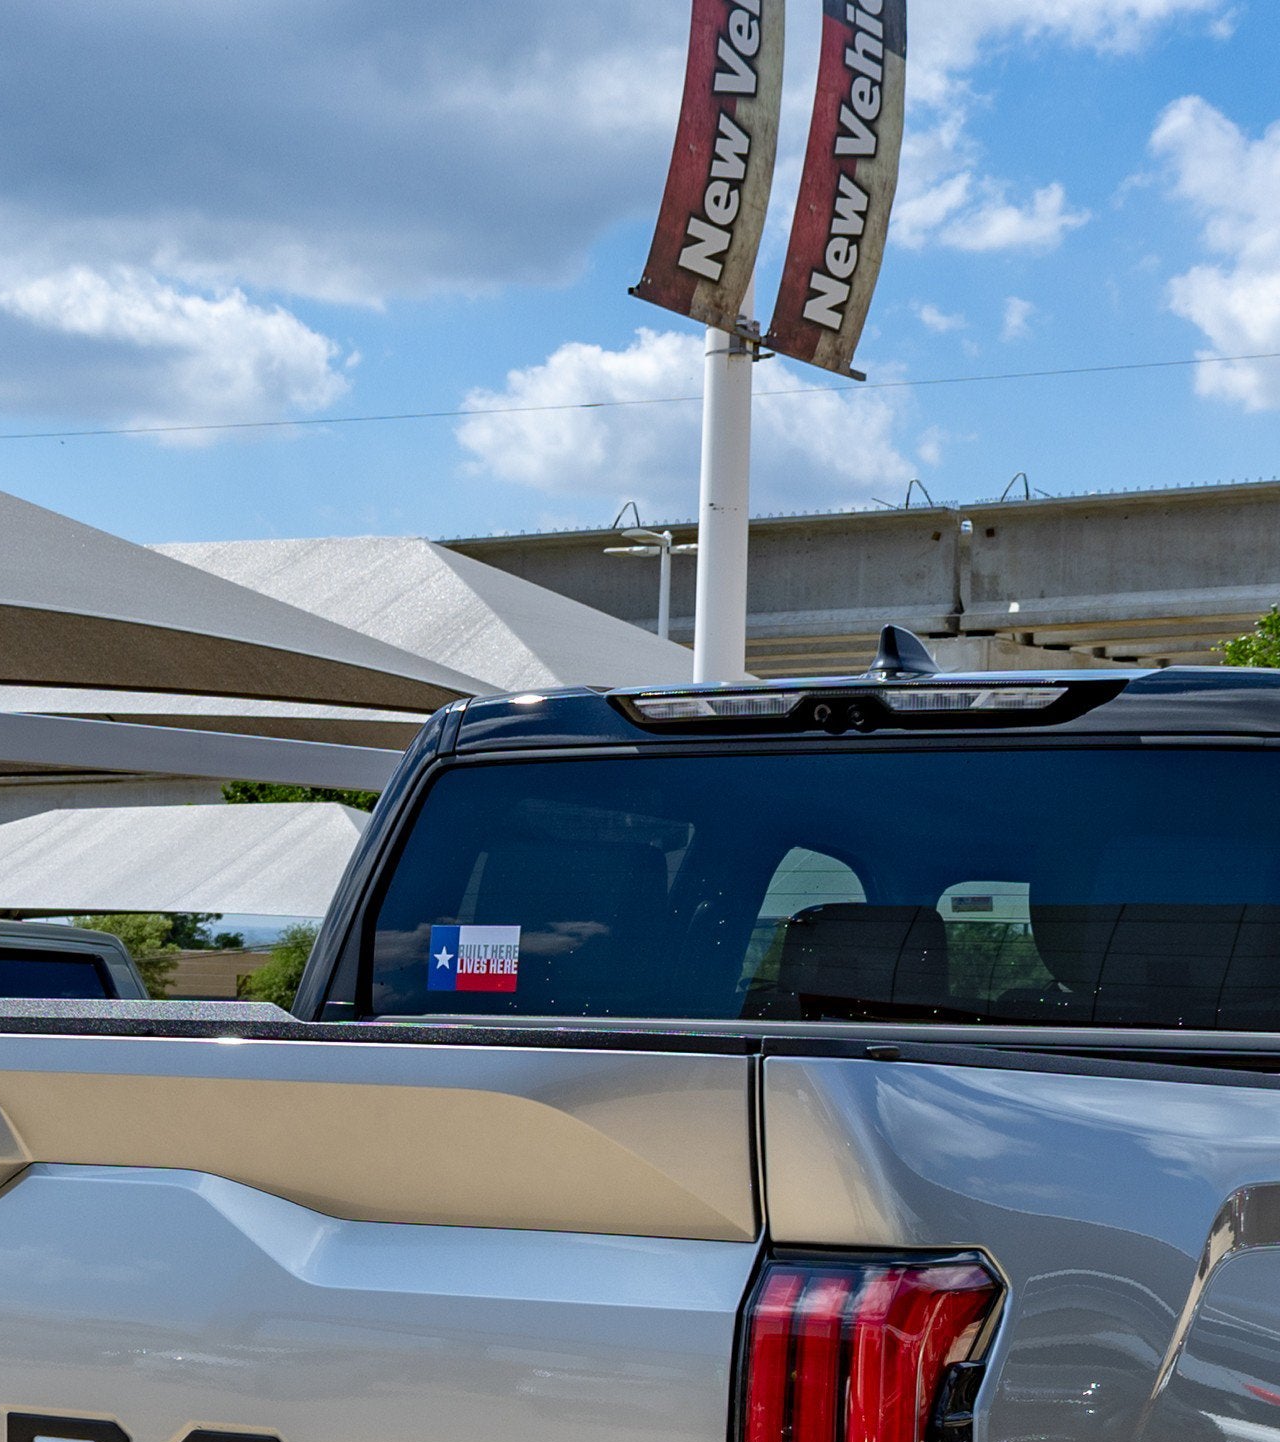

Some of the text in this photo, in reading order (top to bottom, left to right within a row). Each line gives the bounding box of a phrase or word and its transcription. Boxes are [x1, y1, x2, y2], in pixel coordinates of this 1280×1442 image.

[677, 112, 752, 283] New
[801, 174, 869, 331] New
[457, 958, 518, 974] LIVES HERE
[458, 944, 519, 959] BUILT HERE
